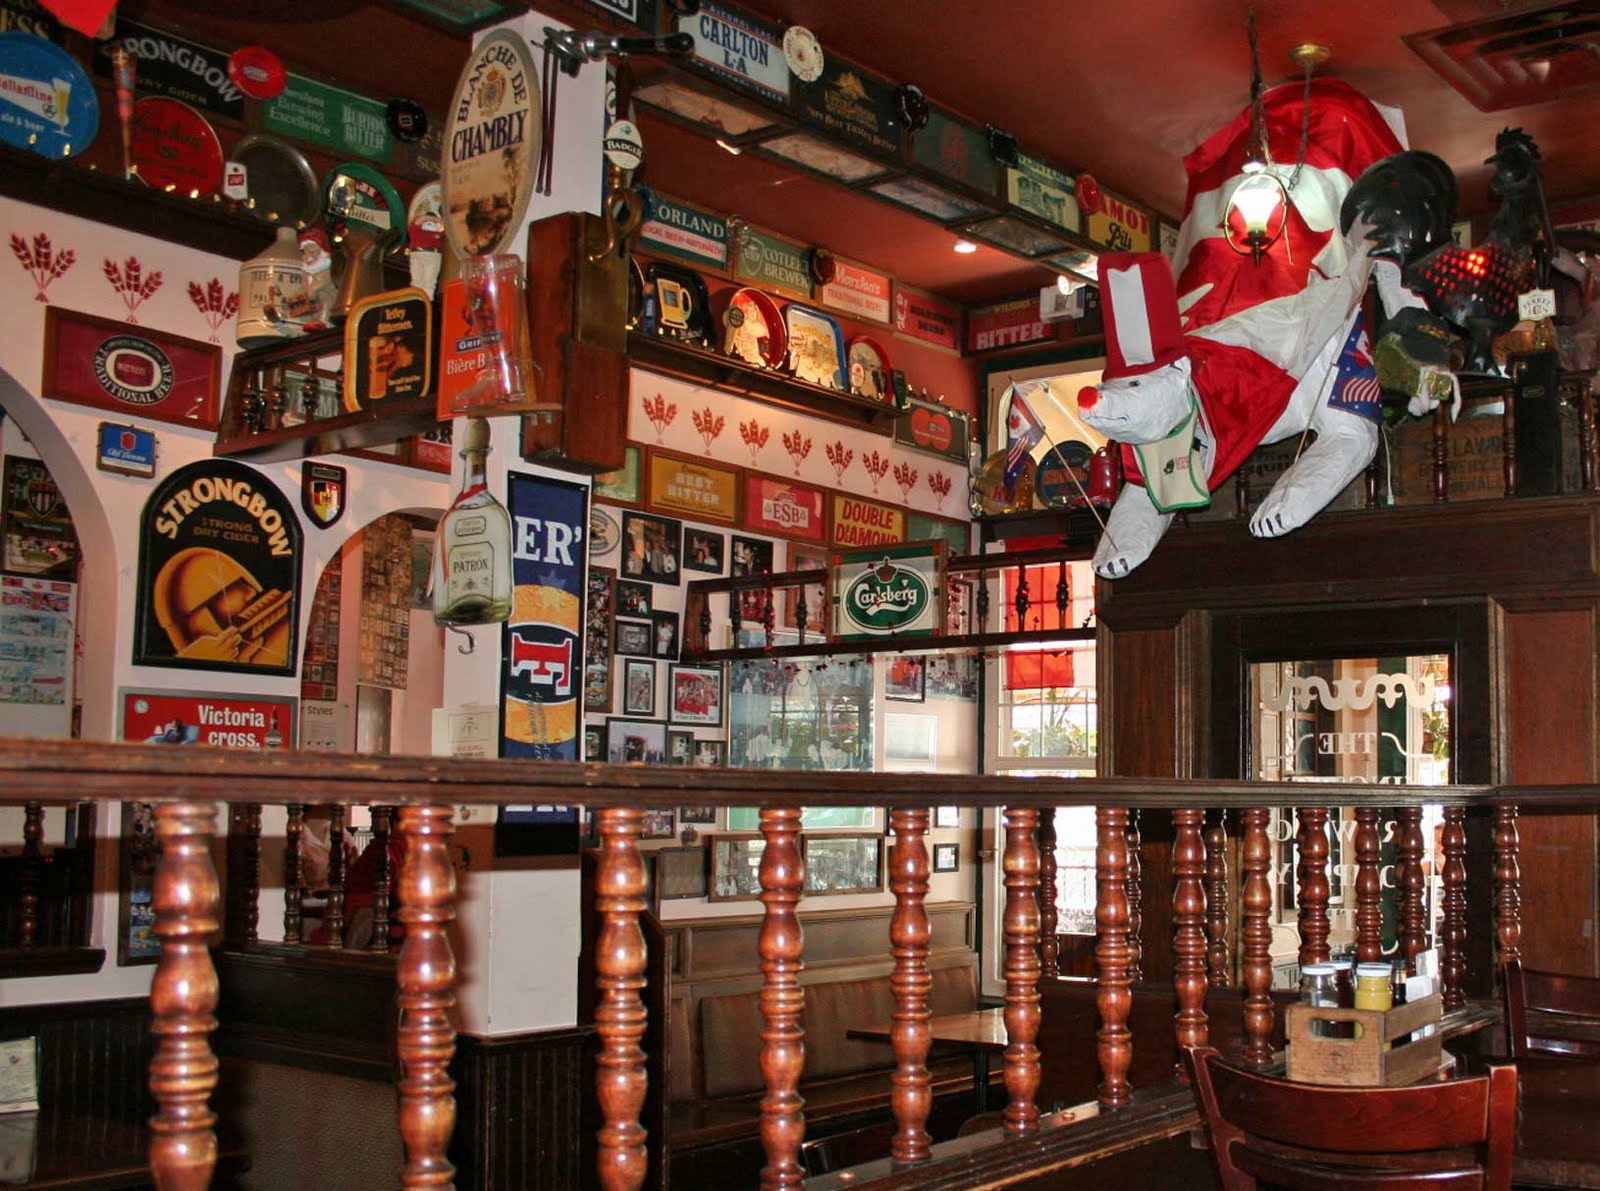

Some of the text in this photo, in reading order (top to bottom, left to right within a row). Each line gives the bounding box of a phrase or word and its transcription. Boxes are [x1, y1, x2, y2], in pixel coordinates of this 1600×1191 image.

[700, 15, 769, 67] CARLTON
[457, 46, 527, 122] BLANCHE DE
[345, 125, 385, 150] BITTER
[452, 109, 529, 163] CHAMBLY
[606, 141, 643, 159] BADGER
[1105, 222, 1132, 251] Pils
[834, 264, 881, 297] Marston's
[975, 321, 1045, 350] BITTER
[95, 346, 173, 403] TRADITIONAL BEER
[446, 355, 475, 377] Bière
[675, 472, 714, 488] BEST
[667, 485, 720, 505] BITTER
[156, 477, 293, 557] STRONGBOW
[773, 501, 800, 523] ESB
[842, 500, 894, 529] DOUBLE
[193, 526, 260, 543] DRY CIDER
[200, 517, 254, 532] STRONG
[835, 523, 899, 547] DIAMOND
[854, 582, 918, 610] Carlsberg
[198, 704, 266, 728] Victoria
[307, 705, 334, 717] Styles
[208, 730, 260, 748] cross.
